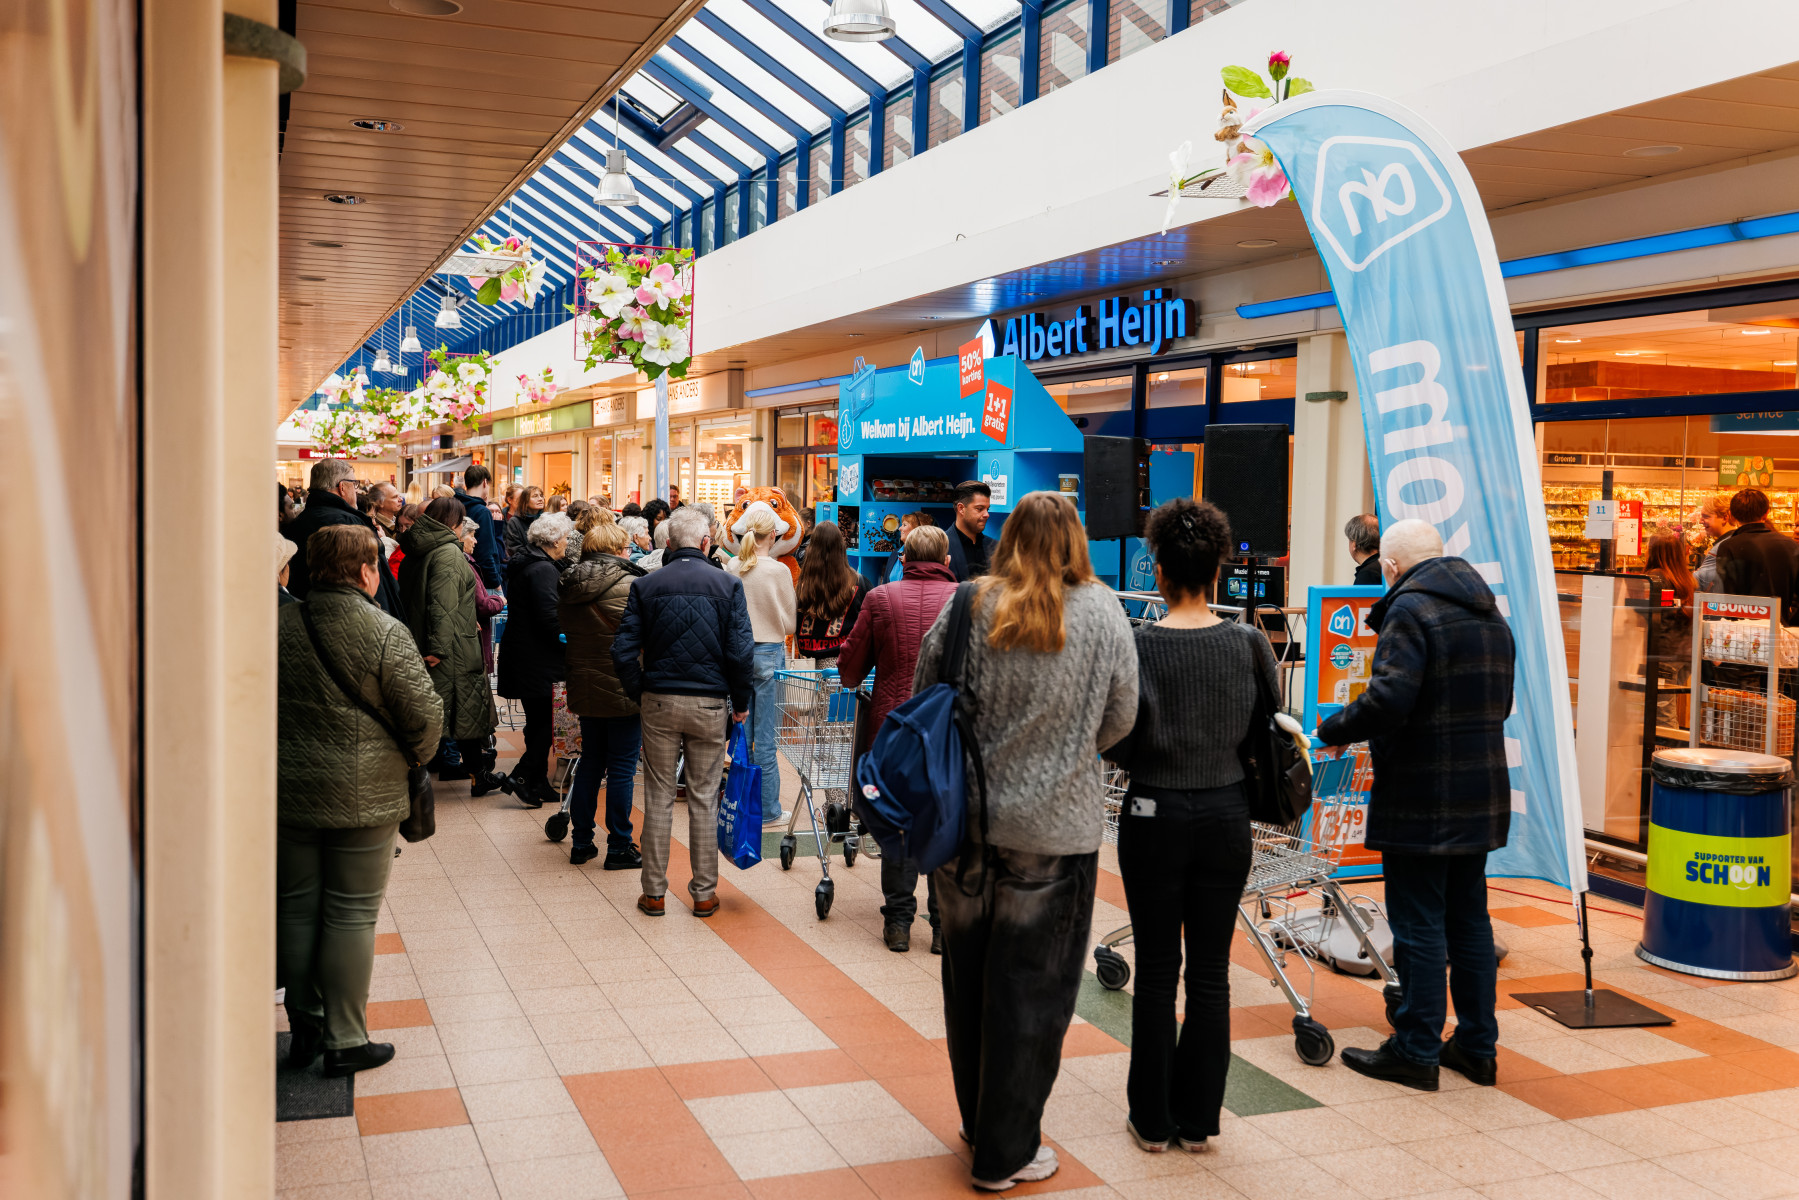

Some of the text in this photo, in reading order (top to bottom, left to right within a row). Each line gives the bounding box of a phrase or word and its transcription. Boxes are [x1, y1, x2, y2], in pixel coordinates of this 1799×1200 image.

[1002, 289, 1187, 360] Albert Heijn
[961, 348, 982, 374] 50%
[962, 369, 982, 386] korting
[986, 392, 1007, 419] 1+1
[861, 412, 976, 442] Welkom bij Albert Heijn.
[984, 414, 1005, 433] gratis
[1554, 454, 1576, 463] Groente
[1596, 505, 1606, 515] 11
[1719, 602, 1768, 615] BONUS
[1694, 851, 1764, 864] SUPPORTER VAN
[1685, 860, 1770, 887] SCHOON
